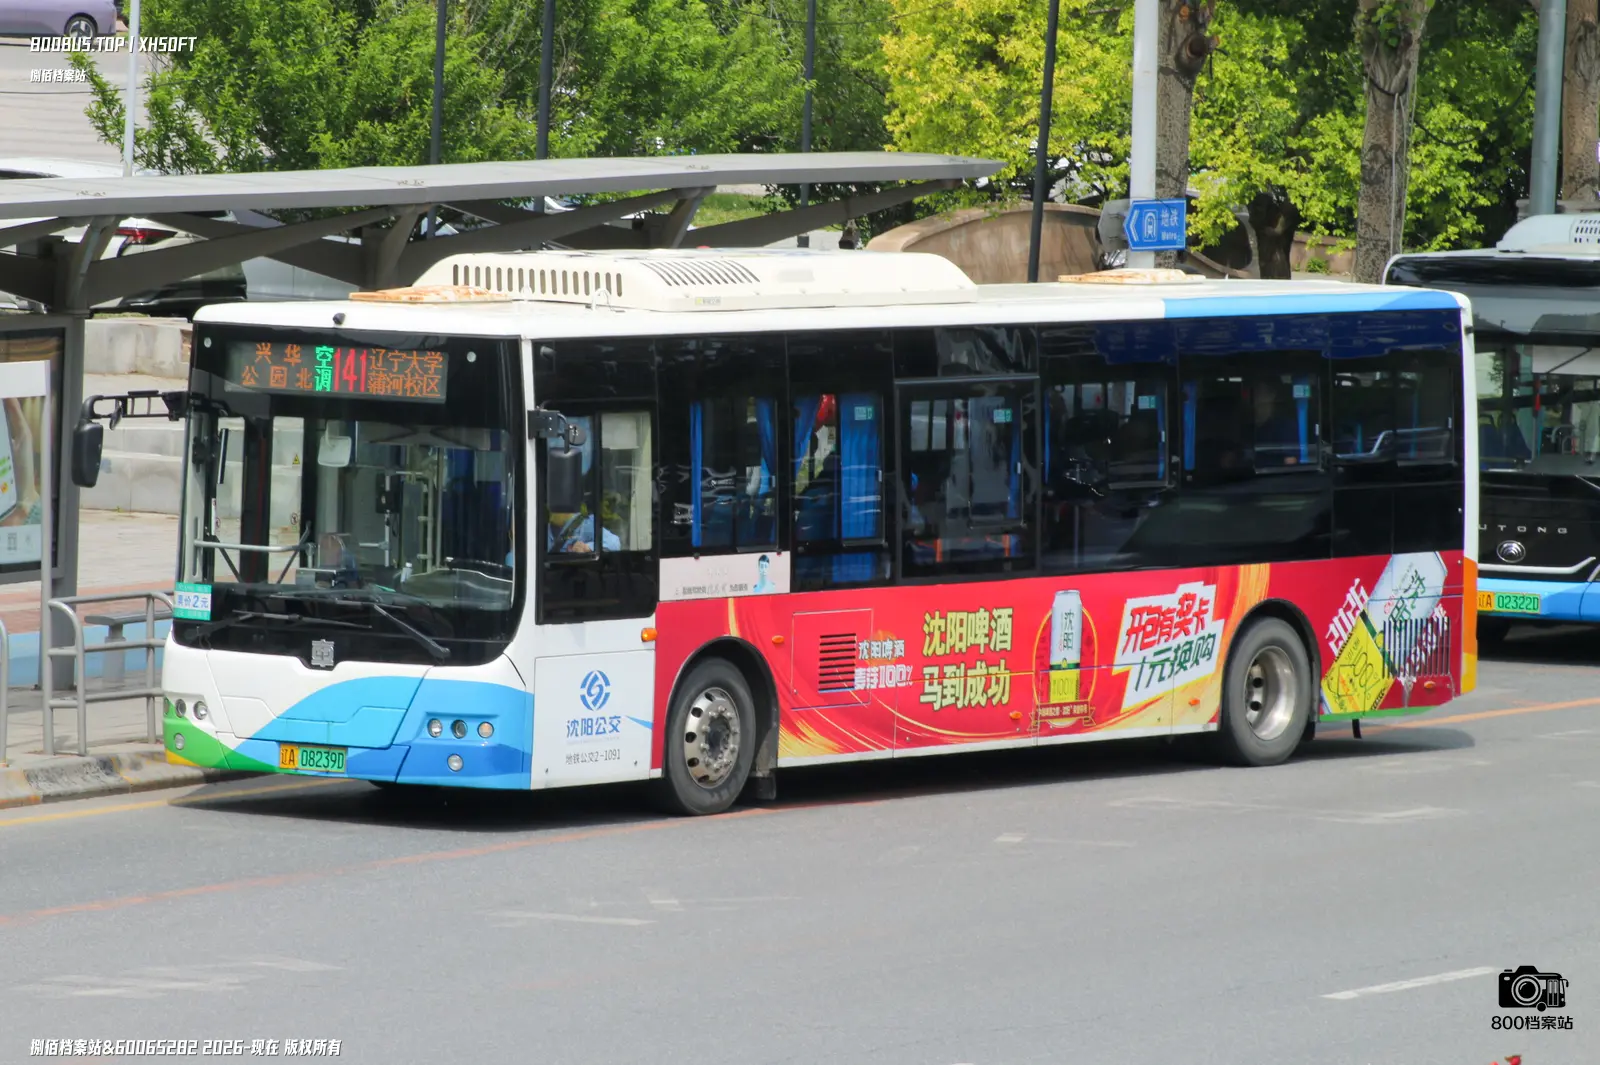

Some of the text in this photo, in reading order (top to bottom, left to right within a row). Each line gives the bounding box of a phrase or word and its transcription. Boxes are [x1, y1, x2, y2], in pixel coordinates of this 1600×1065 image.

[255, 342, 302, 366] 兴华
[367, 348, 444, 375] 辽宁大学
[241, 366, 312, 389] 公园北
[315, 345, 334, 393] 空调
[334, 348, 368, 393] 141
[367, 371, 441, 398] 蒲河校区
[922, 607, 1013, 657] 沈阳啤酒
[920, 658, 1012, 711] 马到成功
[566, 715, 622, 738] 沈阳公交
[279, 749, 345, 770] 辽A08239D
[565, 748, 621, 765] 地铁公交2-1091
